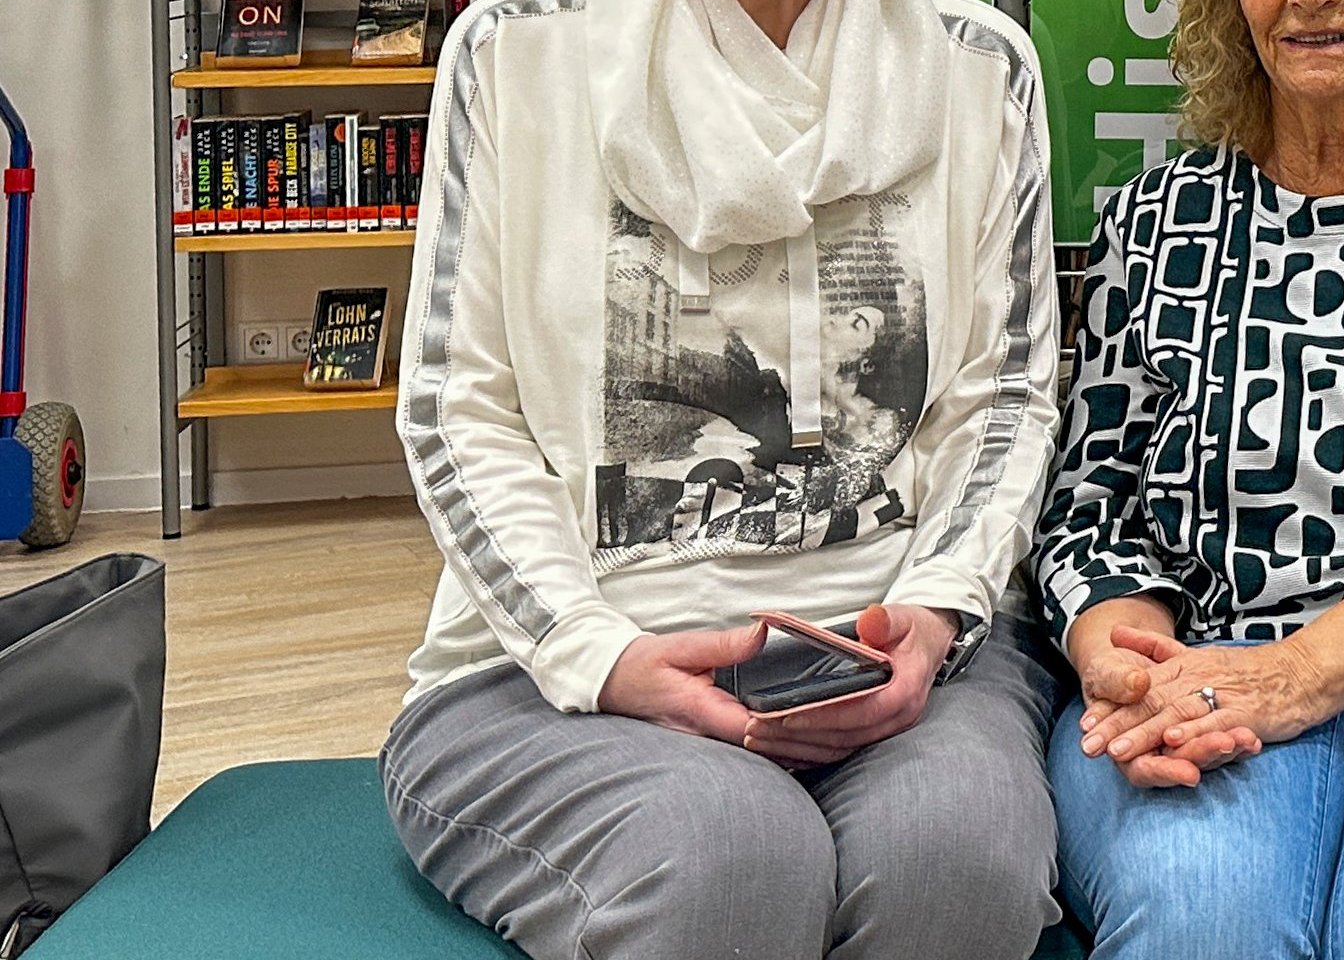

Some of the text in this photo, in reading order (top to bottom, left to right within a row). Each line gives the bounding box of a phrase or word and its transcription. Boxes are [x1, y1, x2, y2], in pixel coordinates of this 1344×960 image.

[238, 5, 282, 26] ON
[285, 123, 298, 140] CITY
[199, 158, 211, 210] AS ENDE
[221, 157, 234, 210] AS SPIEL
[245, 154, 257, 199] NACHT
[267, 159, 280, 192] SPUR
[286, 178, 298, 198] BECK
[328, 303, 367, 326] LOHN
[316, 324, 376, 349] VERRATS
